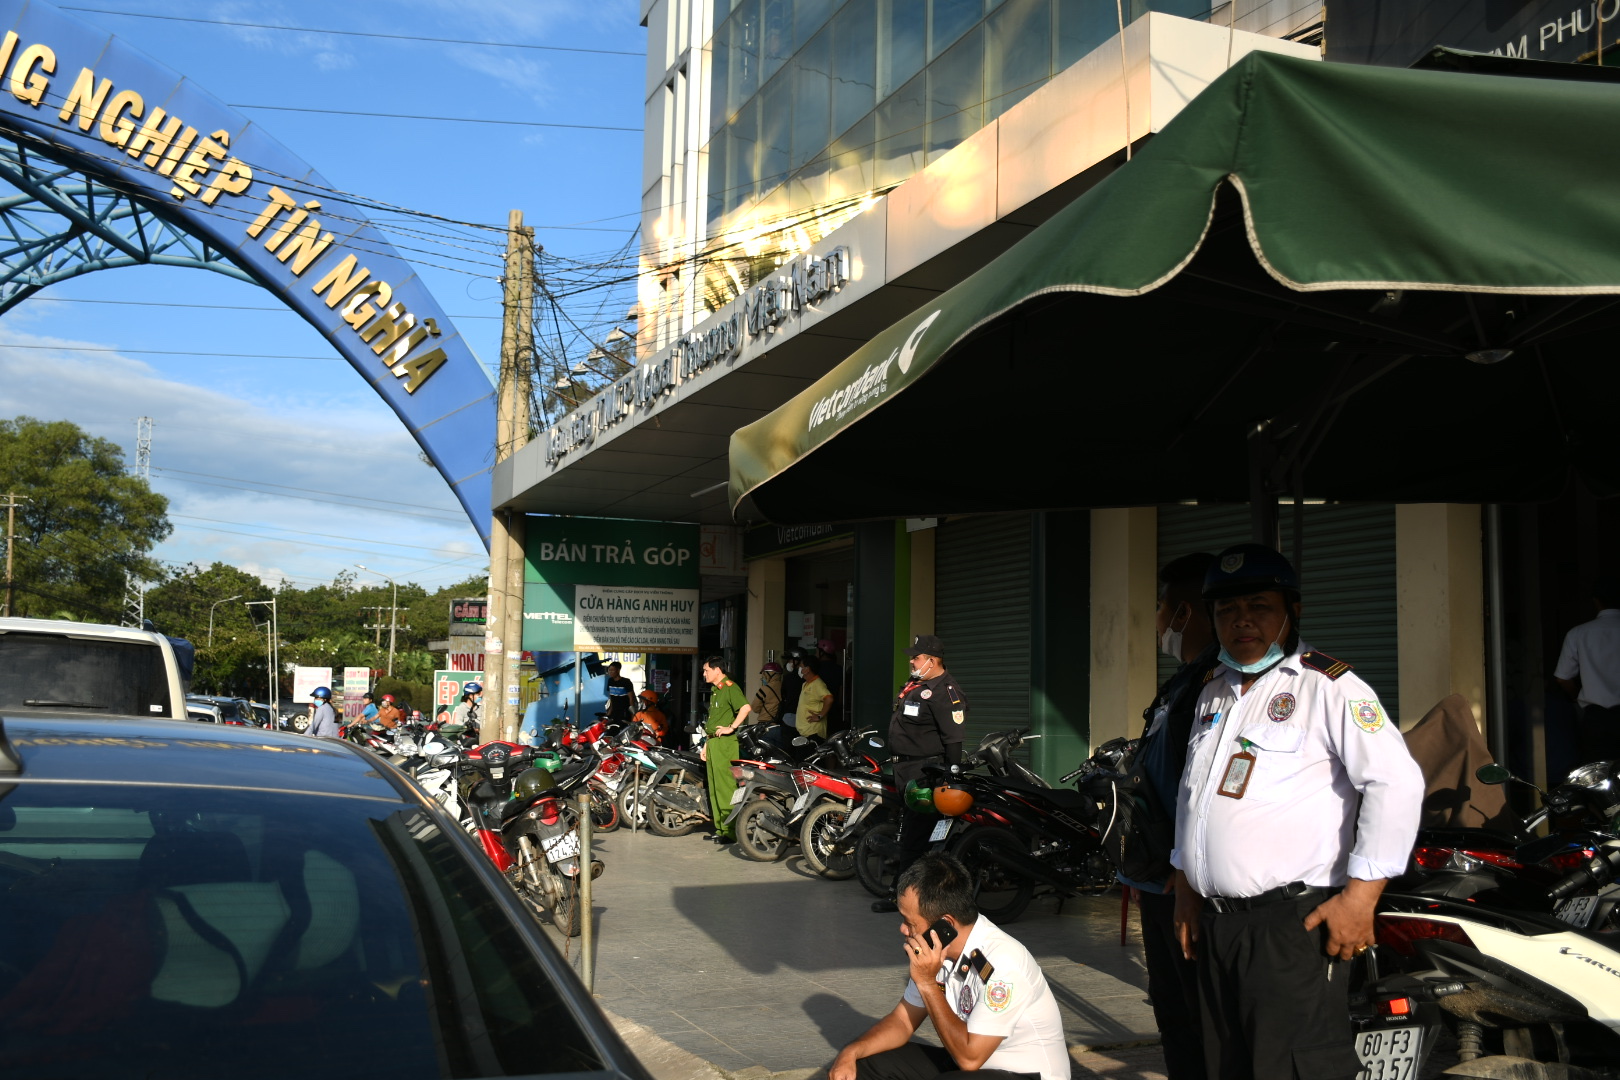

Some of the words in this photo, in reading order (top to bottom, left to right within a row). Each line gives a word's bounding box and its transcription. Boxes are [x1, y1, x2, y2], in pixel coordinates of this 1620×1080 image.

[58, 67, 254, 208] NGHIỆP
[246, 186, 336, 276] TÍN
[312, 253, 448, 395] NGHĨA
[790, 245, 850, 312] Nam
[809, 347, 899, 432] Vietcombank
[540, 538, 587, 562] BÁN
[591, 540, 636, 565] TRẢ
[643, 543, 690, 566] GÓP
[580, 594, 604, 610] CỬA
[606, 596, 640, 611] HÀNG
[642, 599, 668, 612] ANH
[670, 600, 694, 612] HUY
[438, 675, 460, 706] ÉP
[1363, 1030, 1411, 1058] 60-F3
